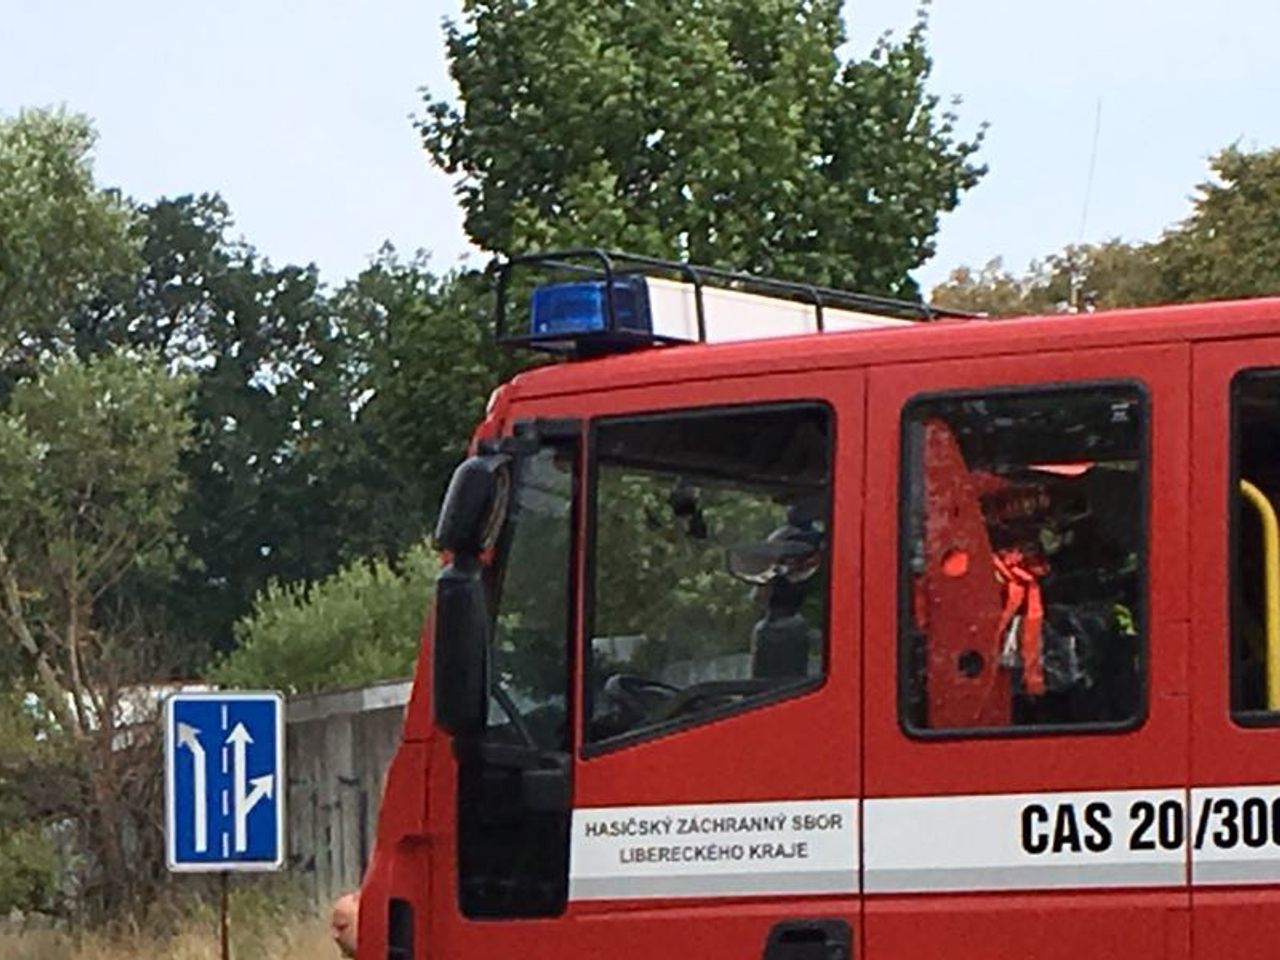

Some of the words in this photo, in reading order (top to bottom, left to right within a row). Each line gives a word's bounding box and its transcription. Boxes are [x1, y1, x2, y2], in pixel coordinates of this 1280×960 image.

[584, 815, 672, 837] HASIČSKÝ
[676, 812, 787, 834] ZÁCHRANNÝ
[791, 813, 843, 831] SBOR
[1021, 803, 1114, 855] CAS
[619, 844, 745, 864] LIBERECKÉHO
[748, 842, 809, 860] KRAJE
